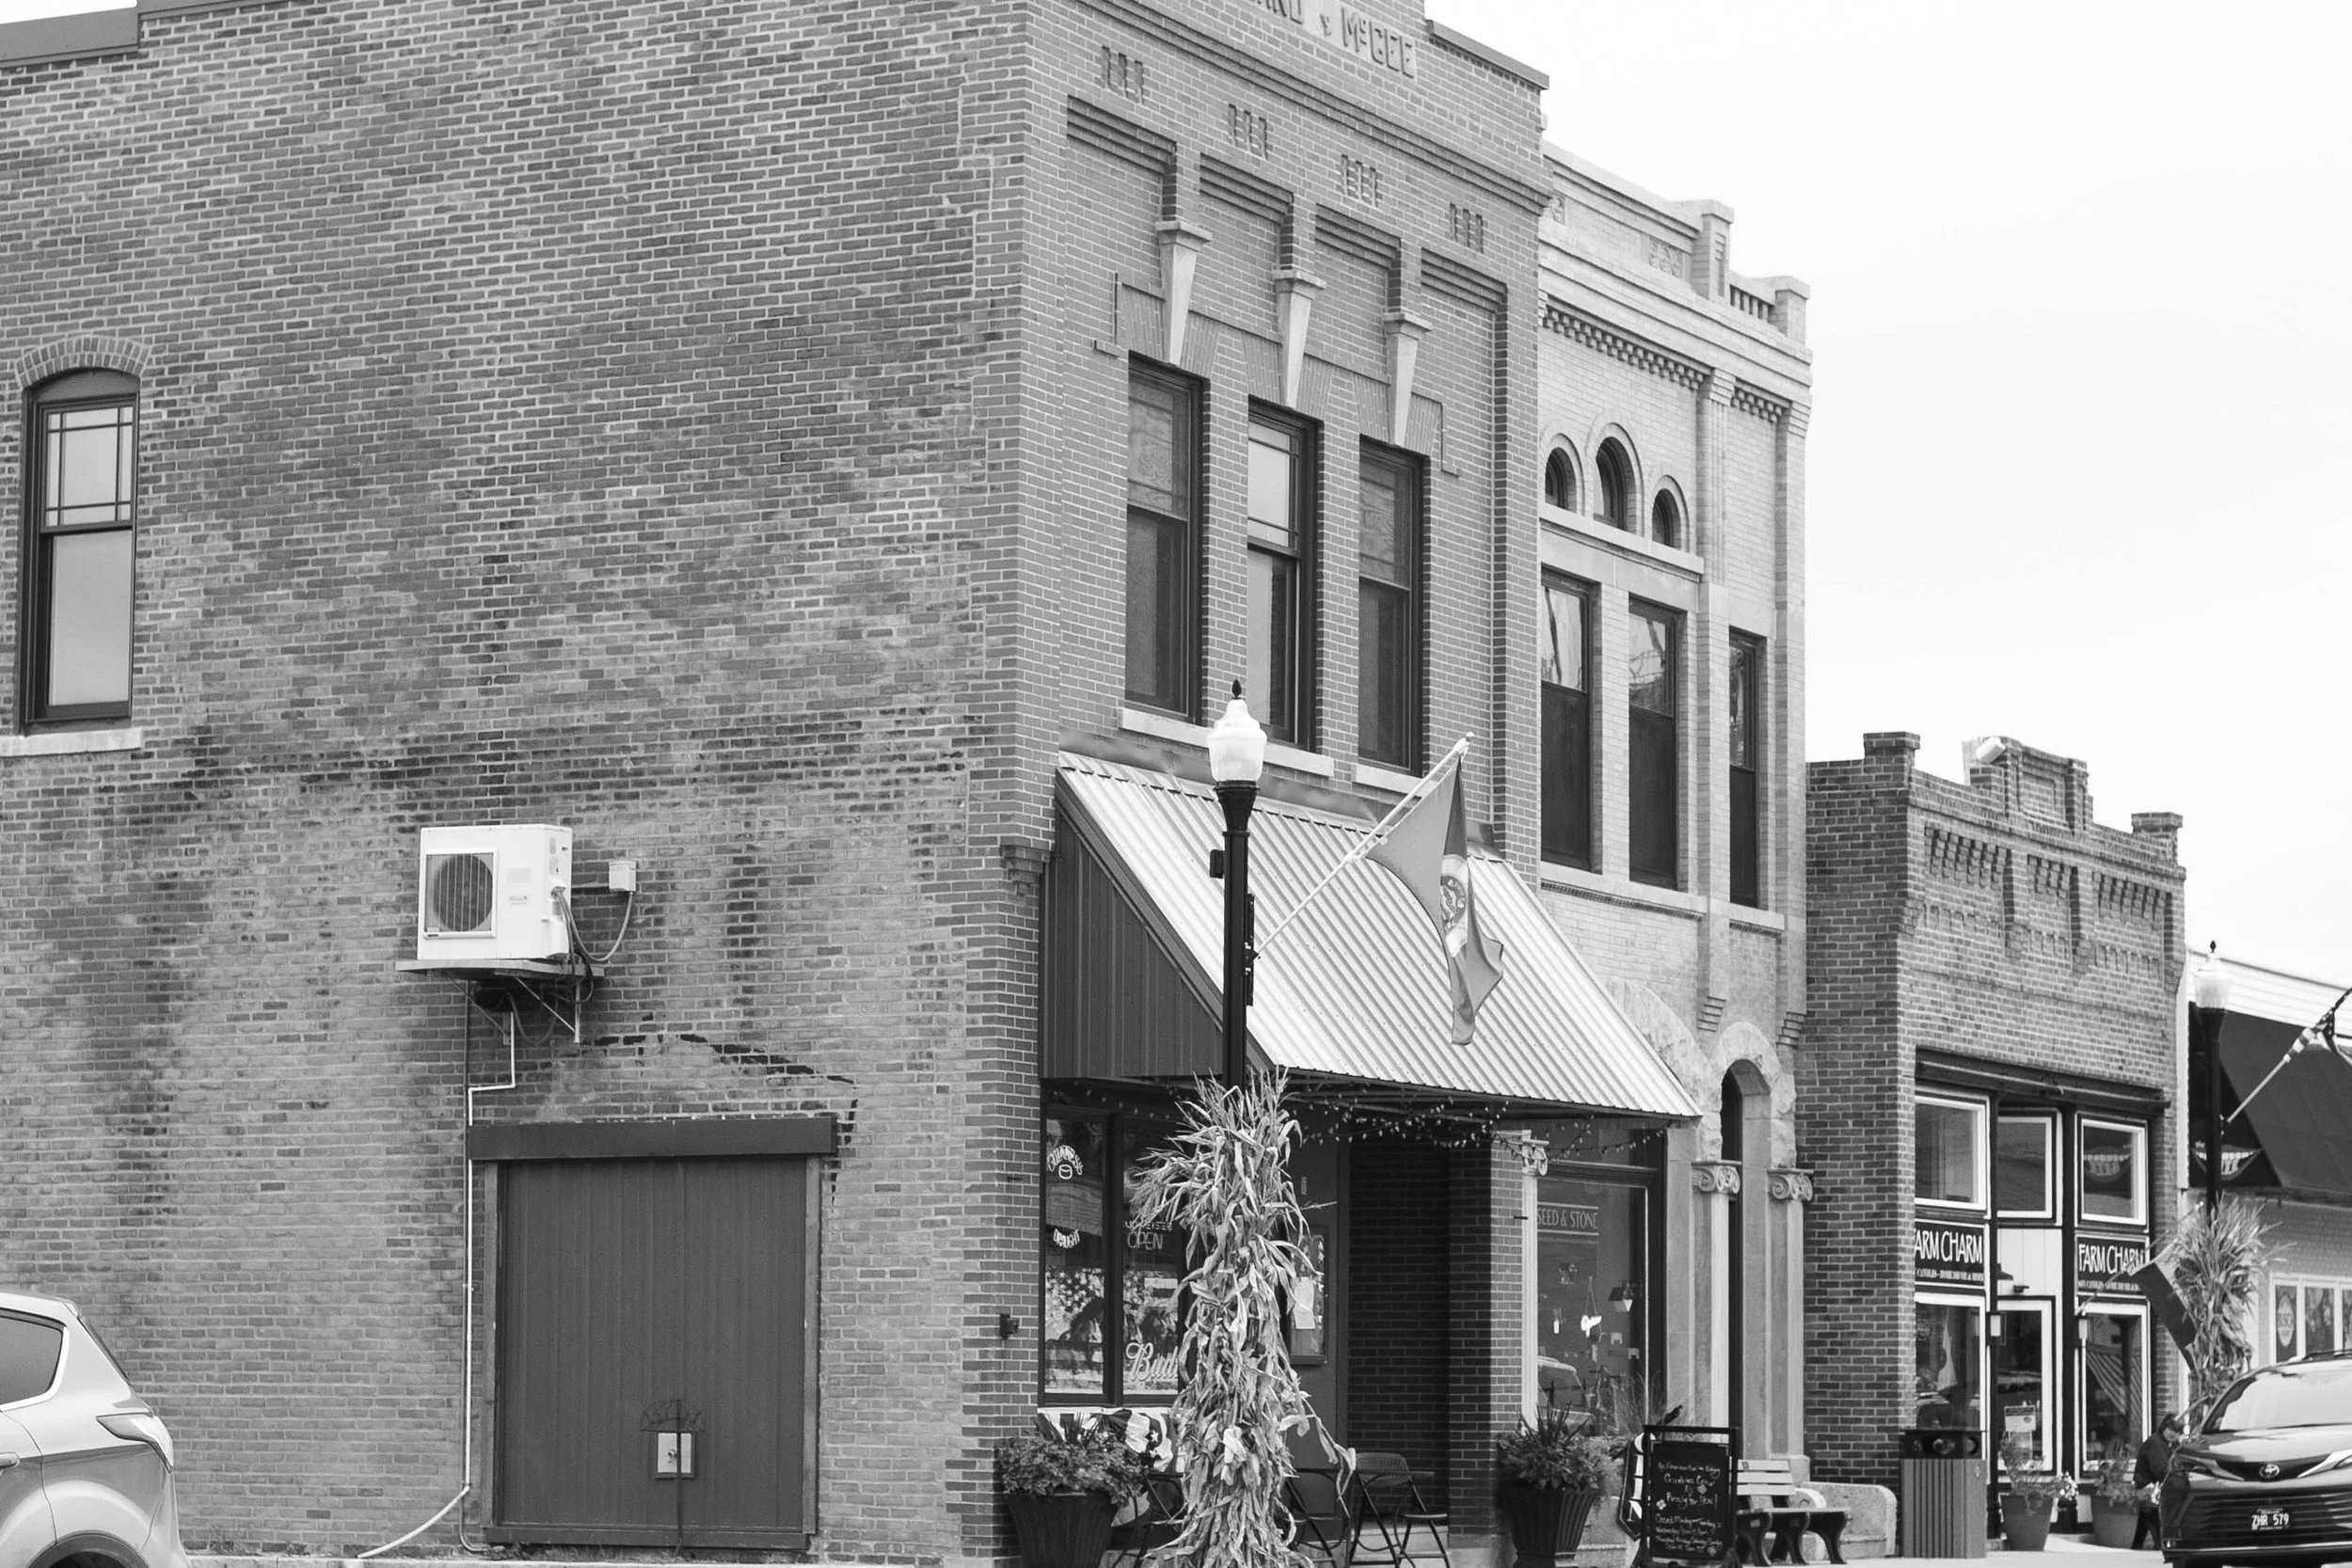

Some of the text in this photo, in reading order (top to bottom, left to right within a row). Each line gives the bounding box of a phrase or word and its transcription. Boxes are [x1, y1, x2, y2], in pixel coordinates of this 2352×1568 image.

[1046, 1145, 1083, 1176] GUINNESS
[1560, 1210, 1568, 1227] &
[1570, 1211, 1599, 1230] STONE
[1127, 1231, 1164, 1250] OPEN
[1915, 1228, 1983, 1264] ARM CHARM
[2078, 1243, 2106, 1274] FARM
[1125, 1341, 1179, 1382] Bud
[2273, 1513, 2290, 1526] 579
